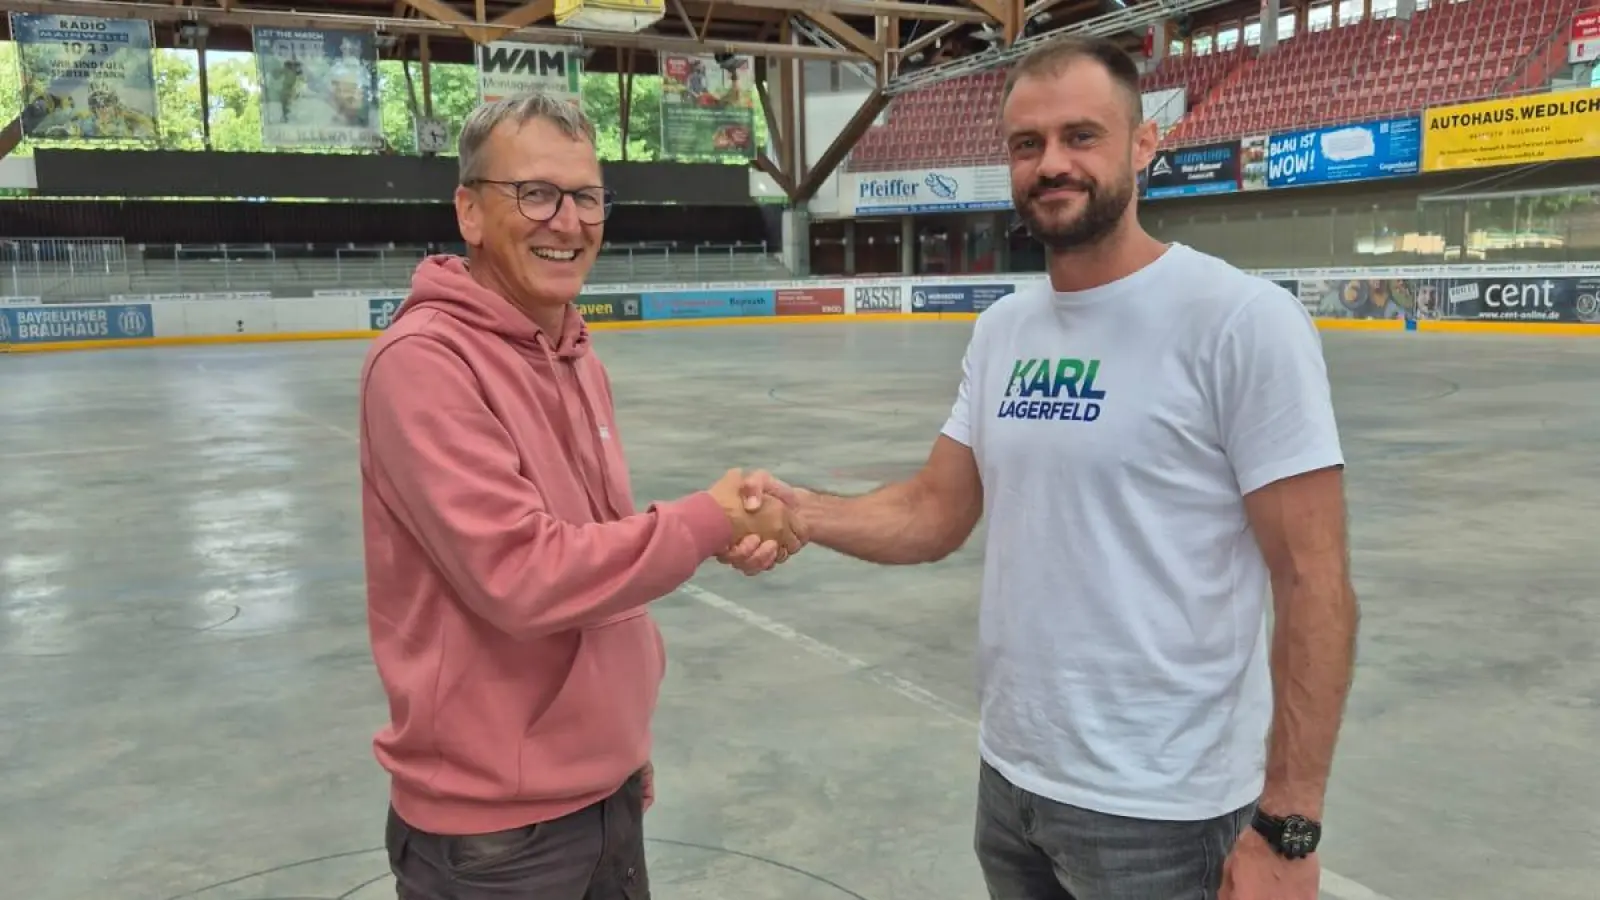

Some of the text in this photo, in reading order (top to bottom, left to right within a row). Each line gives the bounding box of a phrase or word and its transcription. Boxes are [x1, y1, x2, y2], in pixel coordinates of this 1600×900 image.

[60, 19, 106, 31] RADIO
[295, 31, 324, 39] MATCH
[482, 47, 566, 76] WAM
[1430, 99, 1600, 130] AUTOHAUS.WEDLICH
[1270, 137, 1297, 157] BLAU
[1300, 132, 1317, 149] IST
[1269, 150, 1316, 180] WOW!
[860, 179, 920, 198] Pfeiffer
[1485, 280, 1555, 307] cent
[17, 310, 107, 325] BAYREUTHER
[1479, 310, 1560, 320] www.cent-online.de
[19, 322, 109, 338] BRAUHAUS
[1004, 358, 1107, 400] KARL
[997, 400, 1102, 422] LAGERFELD
